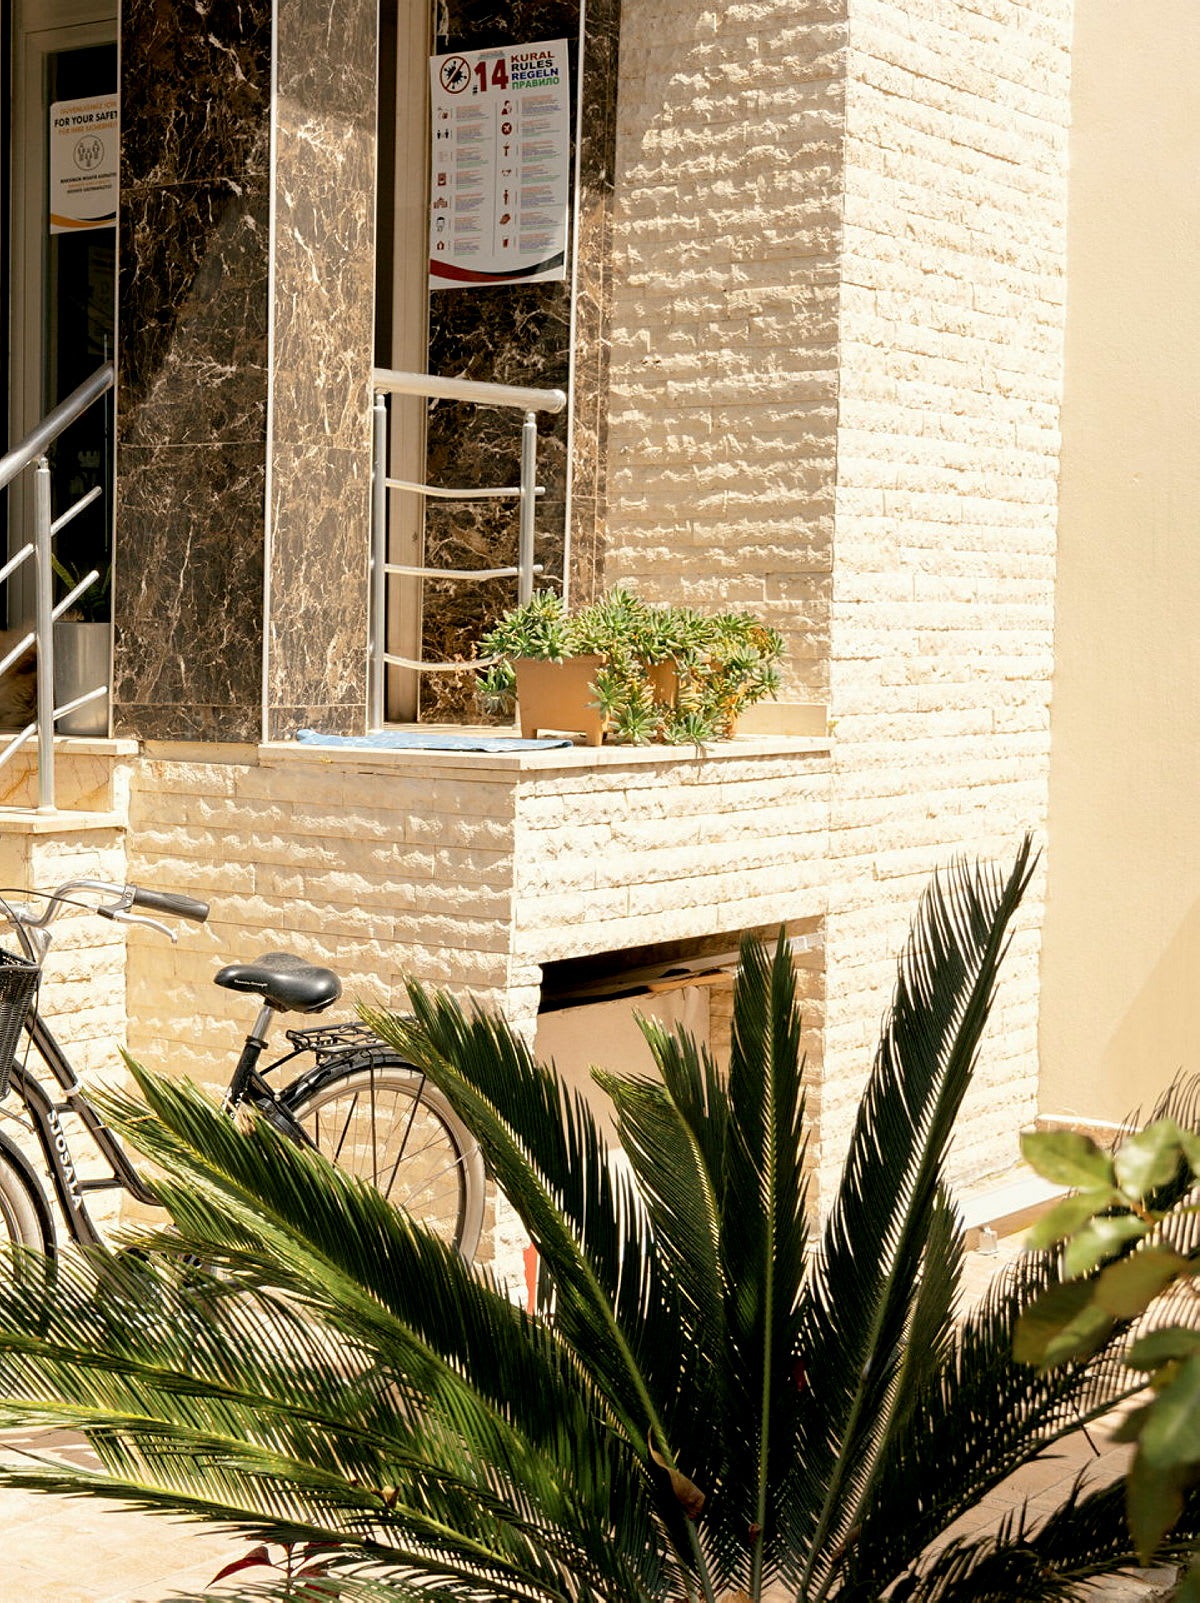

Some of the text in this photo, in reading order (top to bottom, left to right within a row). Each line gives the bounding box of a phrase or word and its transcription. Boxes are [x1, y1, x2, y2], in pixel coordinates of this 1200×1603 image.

[511, 51, 555, 63] KURAL
[511, 59, 553, 72] RULES
[474, 58, 509, 92] 14
[511, 68, 559, 80] REGELN
[511, 77, 560, 90] ПРАВИЛО
[54, 117, 70, 127] FOR
[71, 114, 93, 125] YOUR
